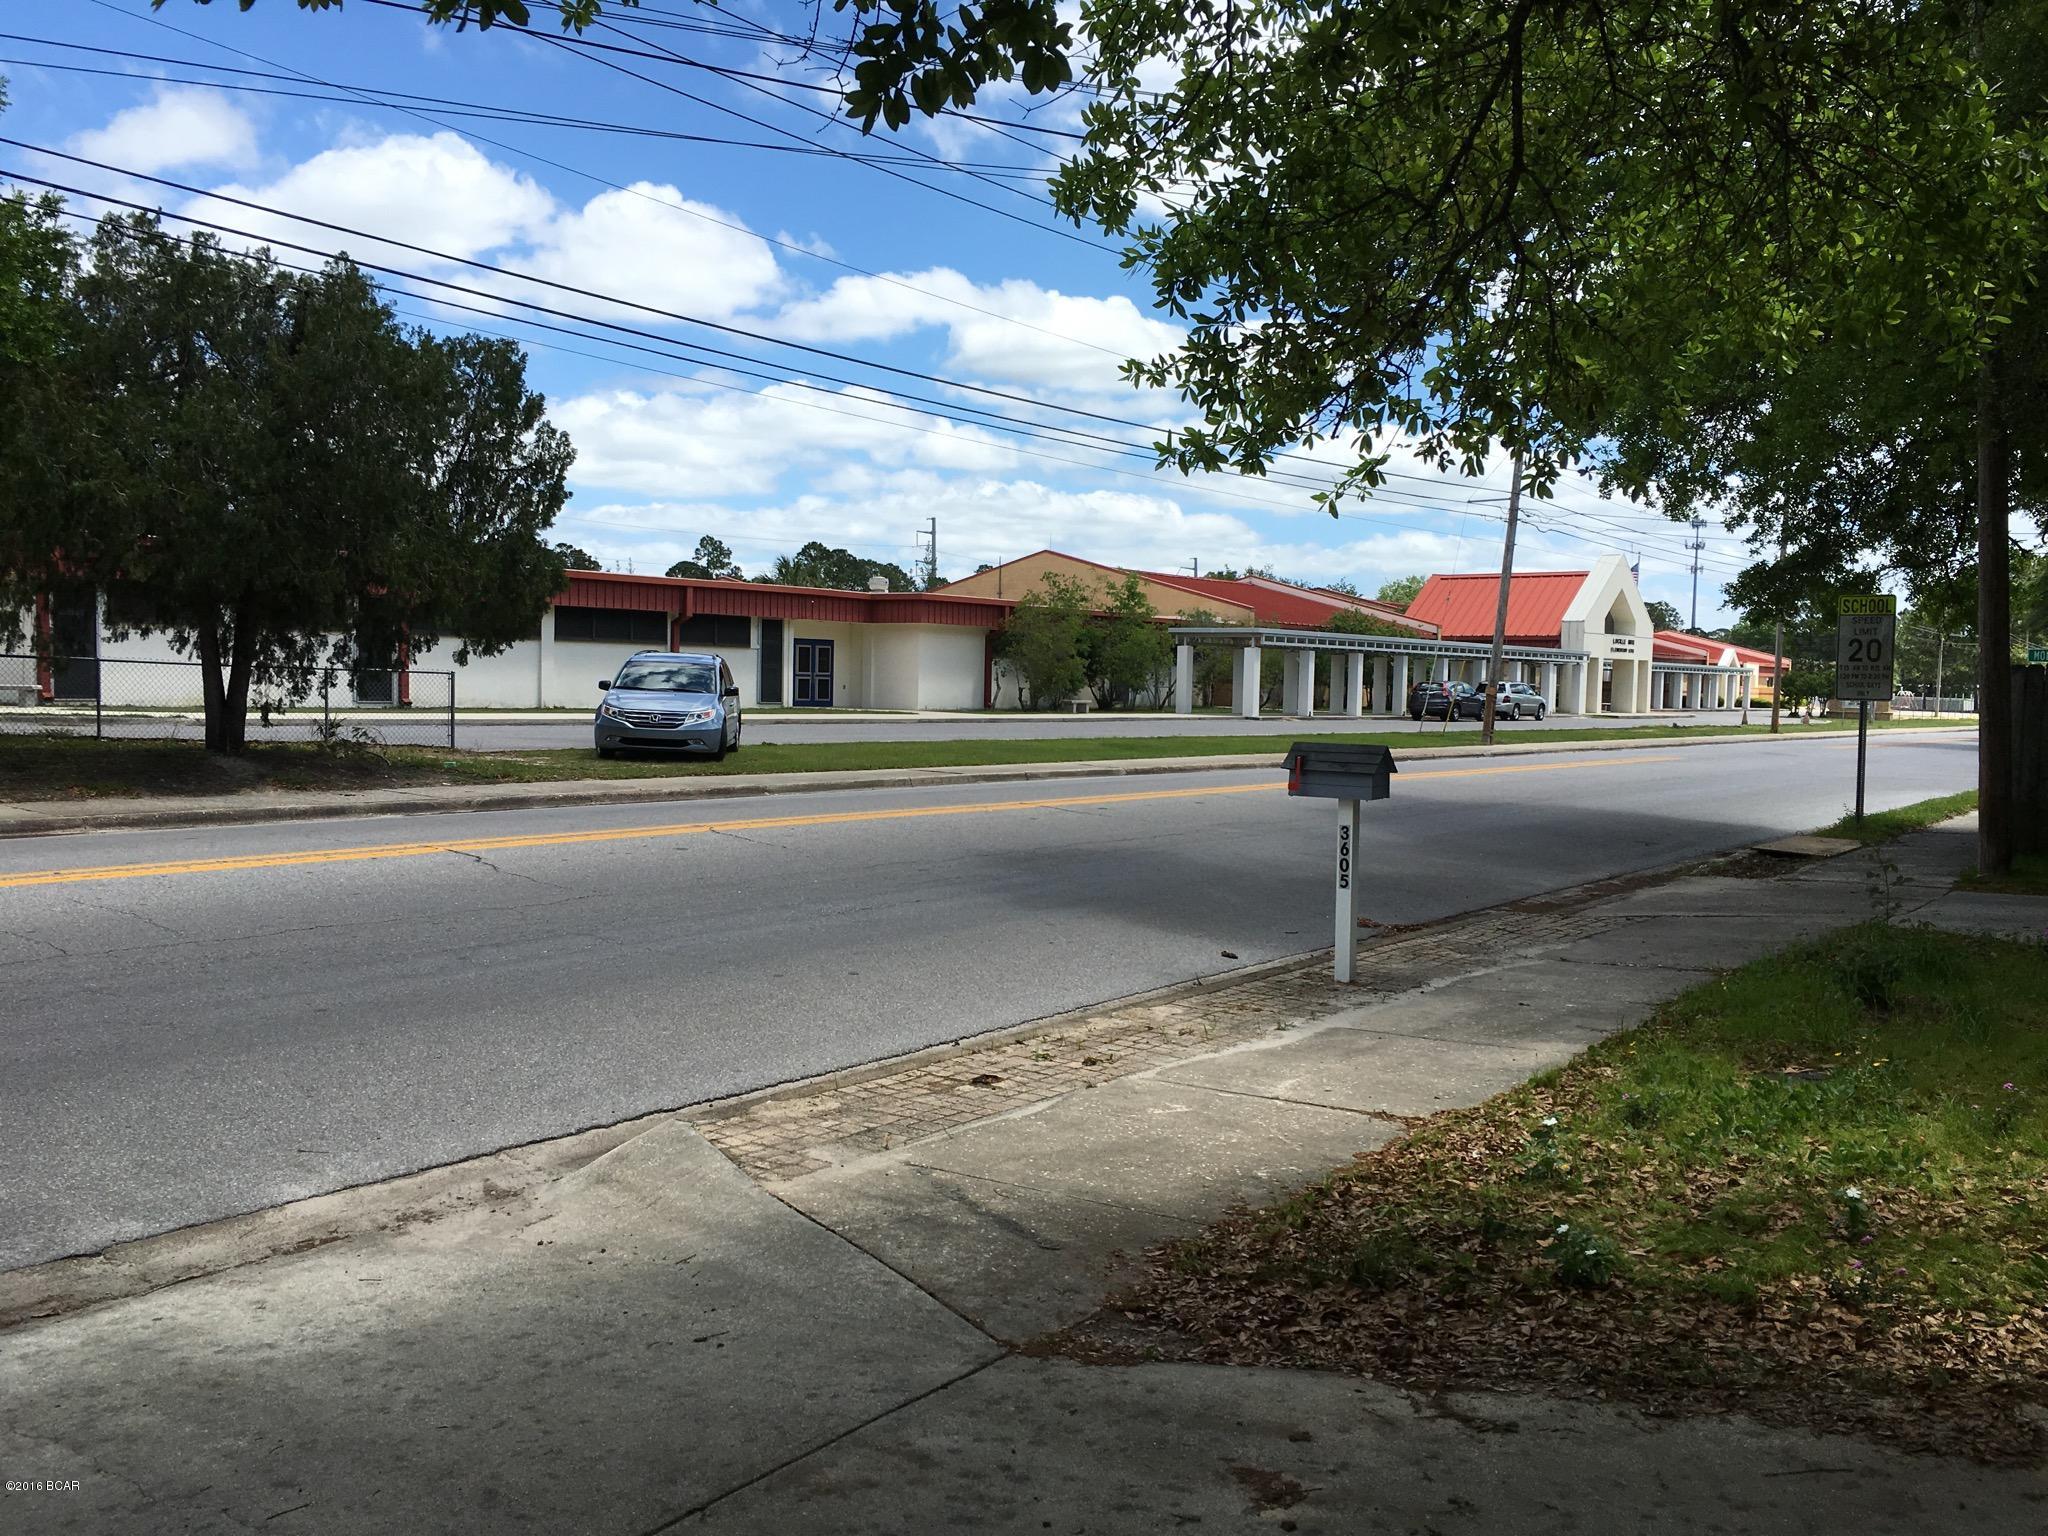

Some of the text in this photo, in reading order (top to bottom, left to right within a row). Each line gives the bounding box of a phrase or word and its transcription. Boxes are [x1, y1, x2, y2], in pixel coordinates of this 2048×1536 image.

[1843, 599, 1892, 613] SCHOOL
[1852, 616, 1882, 624] SPEED
[1854, 627, 1878, 635] LIMIT
[1848, 638, 1882, 662] 20
[1340, 826, 1350, 888] 3605
